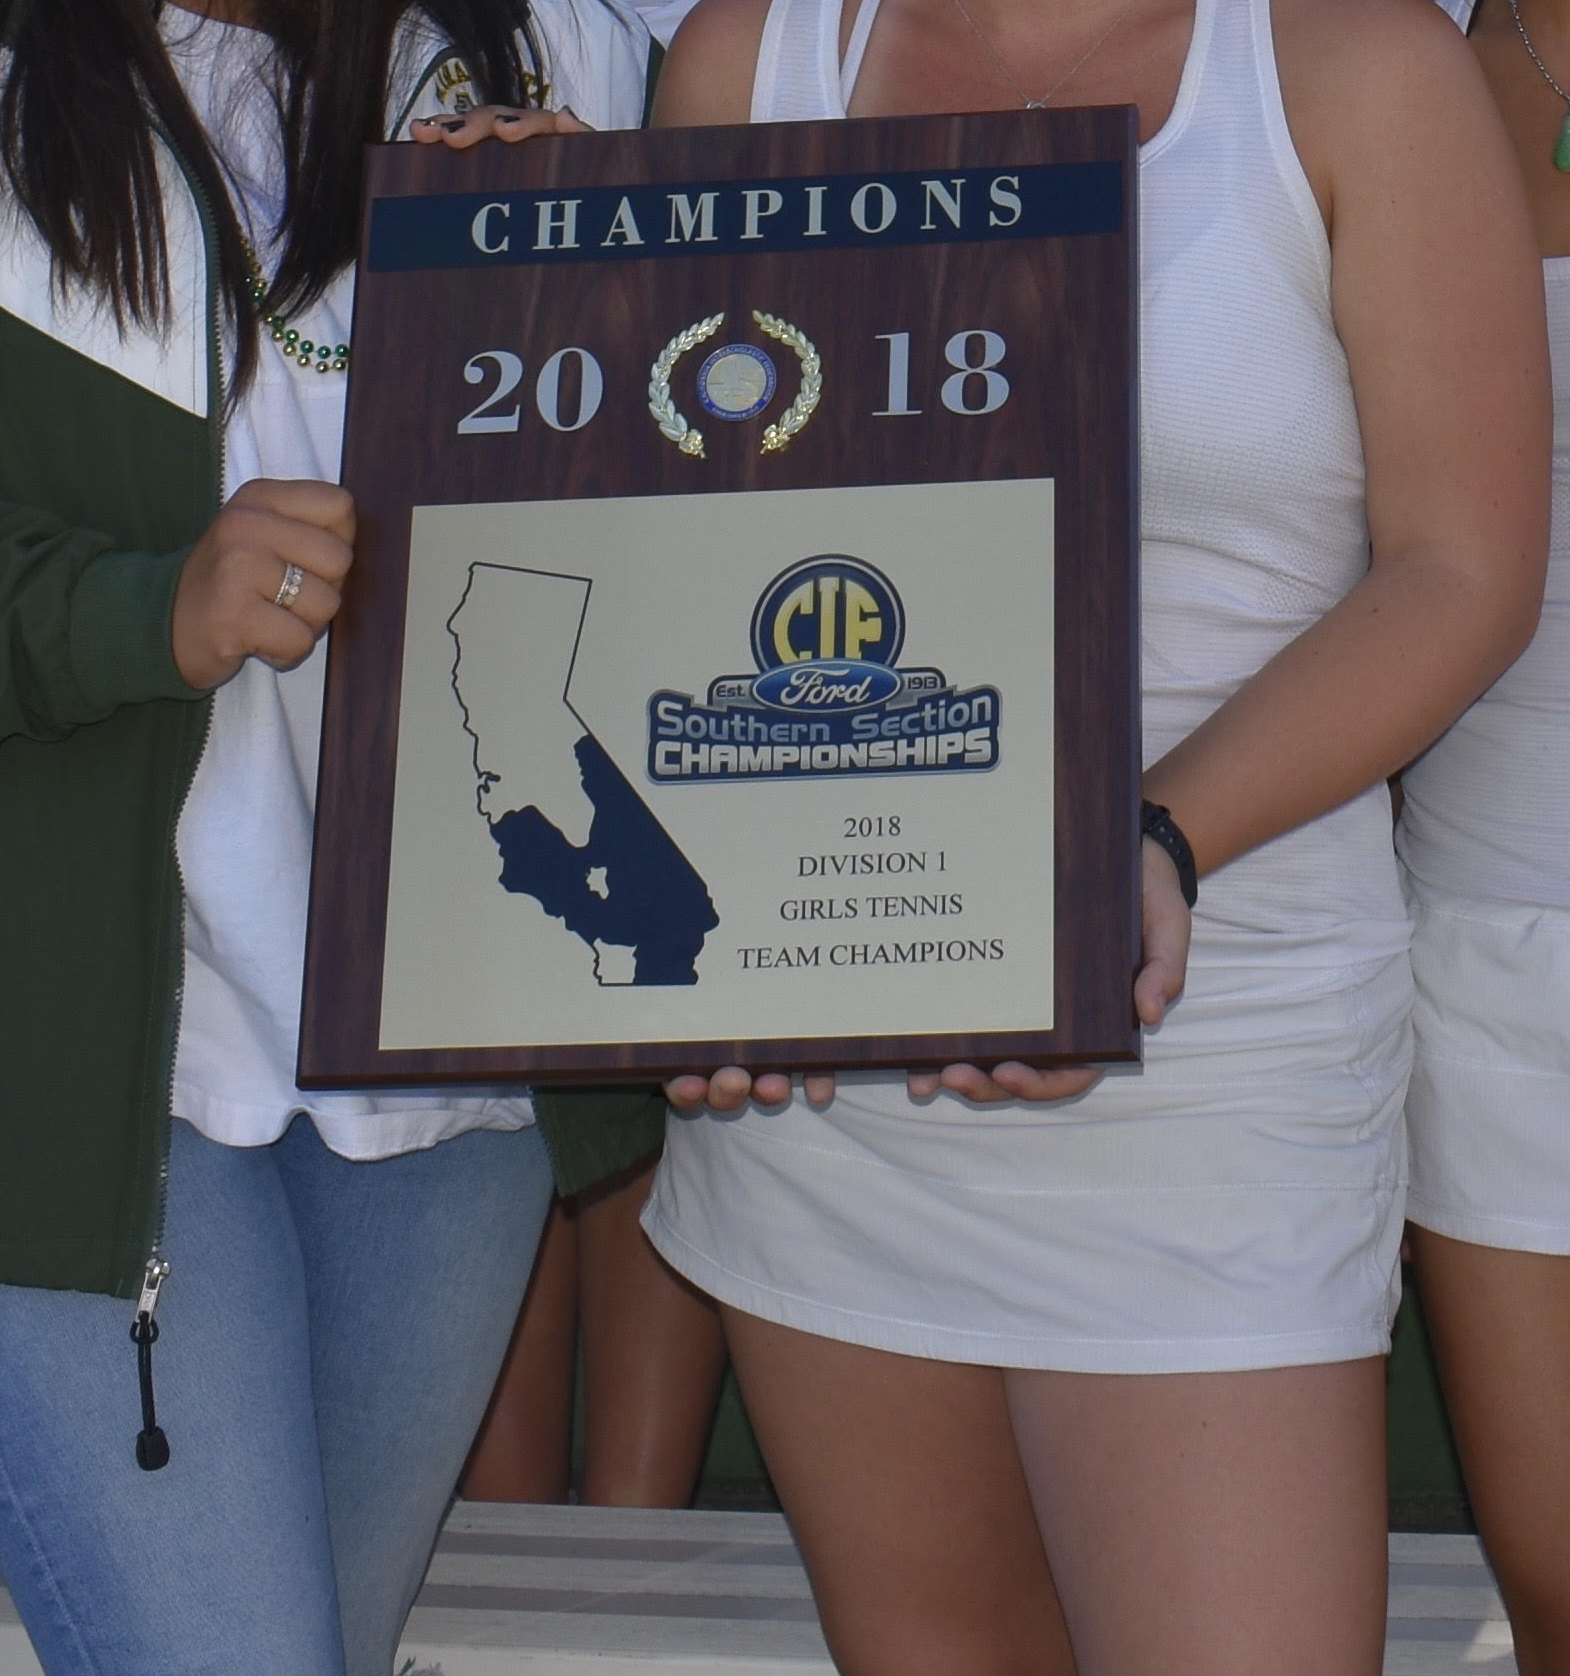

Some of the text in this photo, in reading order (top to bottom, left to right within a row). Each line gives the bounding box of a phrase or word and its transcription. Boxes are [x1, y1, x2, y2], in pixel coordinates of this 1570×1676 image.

[470, 175, 1023, 254] CHAMPIONS
[456, 329, 1011, 435] 20 18
[773, 575, 883, 665] CIF
[715, 683, 747, 698] Est.
[780, 668, 872, 705] Ford
[906, 675, 940, 691] 1913
[656, 694, 993, 743] Southern Section
[653, 726, 992, 774] CHAMPIONSHIPS
[843, 814, 902, 838] 2018
[797, 850, 947, 877] DIVISION 1
[779, 893, 964, 921] GIRLS TENNIS
[736, 938, 1005, 969] TEAM CHAMPIONS
